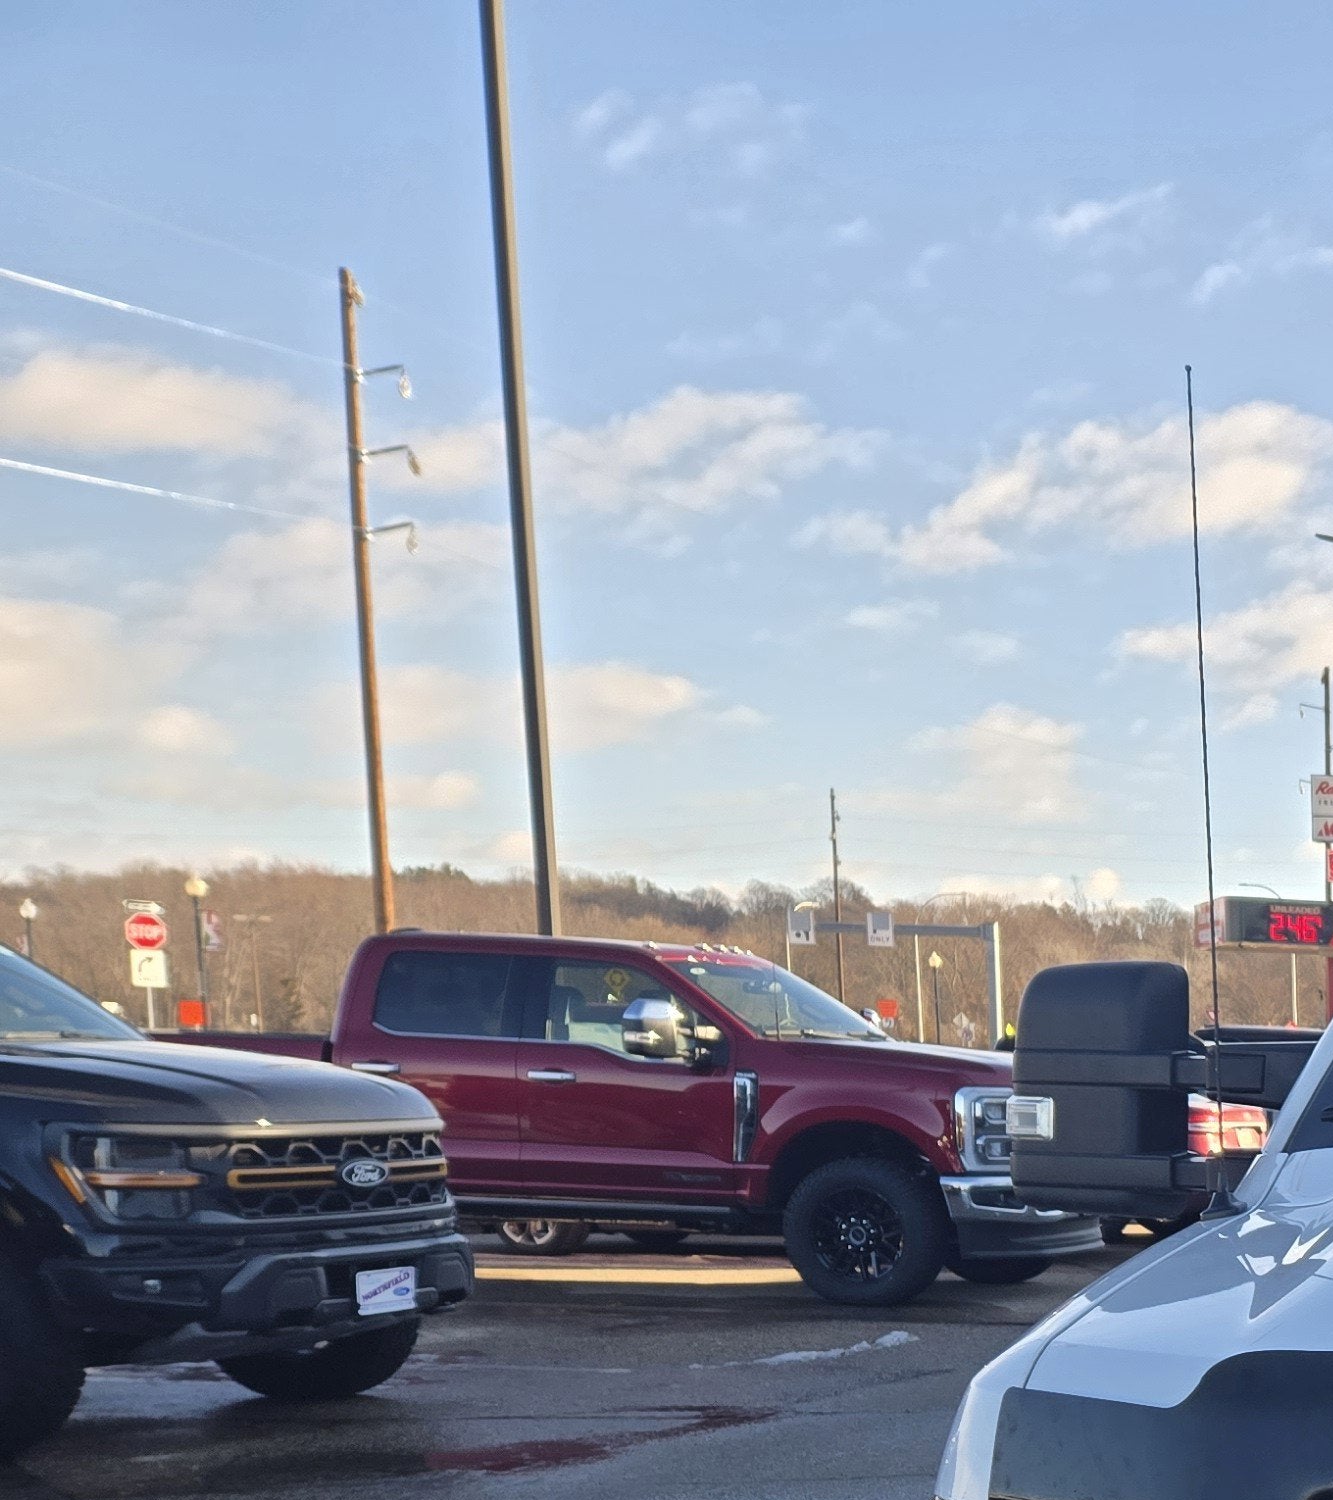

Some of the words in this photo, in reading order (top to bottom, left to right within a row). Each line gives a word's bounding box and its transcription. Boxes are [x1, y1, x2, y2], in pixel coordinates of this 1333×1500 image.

[1270, 905, 1321, 914] UNLEADED
[129, 923, 163, 940] STOP
[351, 1164, 381, 1183] Ford
